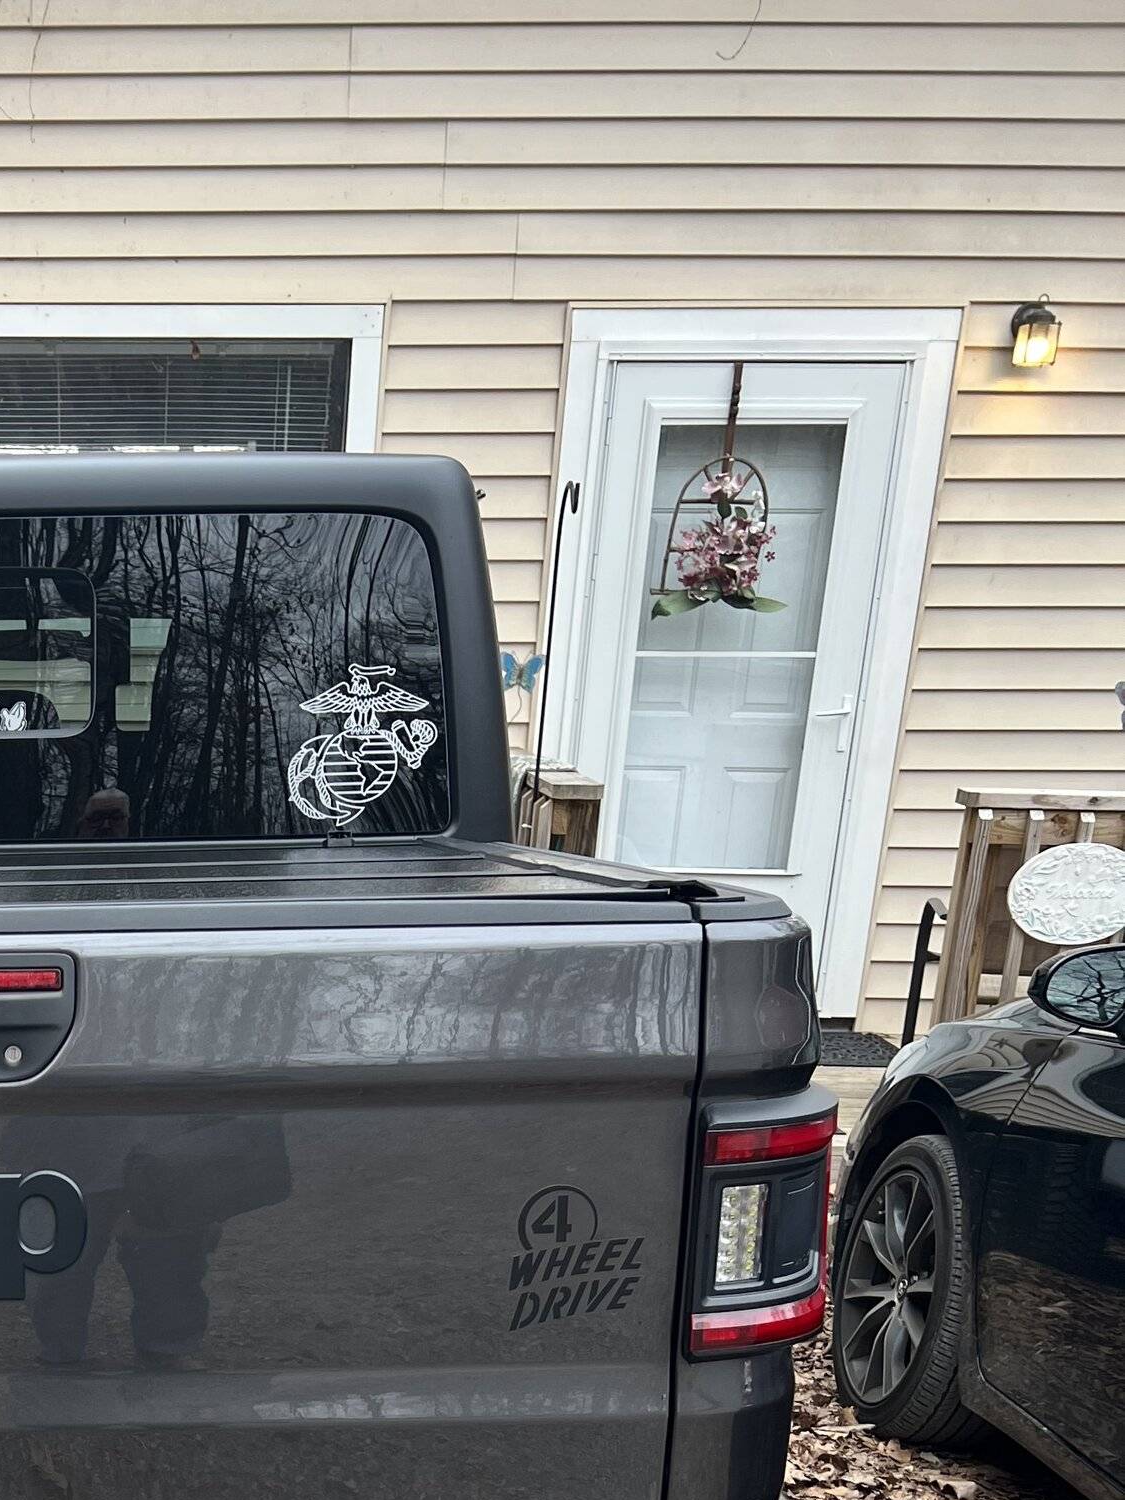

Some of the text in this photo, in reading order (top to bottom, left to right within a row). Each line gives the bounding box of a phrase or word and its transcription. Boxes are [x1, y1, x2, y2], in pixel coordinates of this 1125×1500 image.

[531, 1195, 572, 1242] 4
[509, 1237, 645, 1291] WHEEL
[509, 1276, 641, 1331] DRIVE
